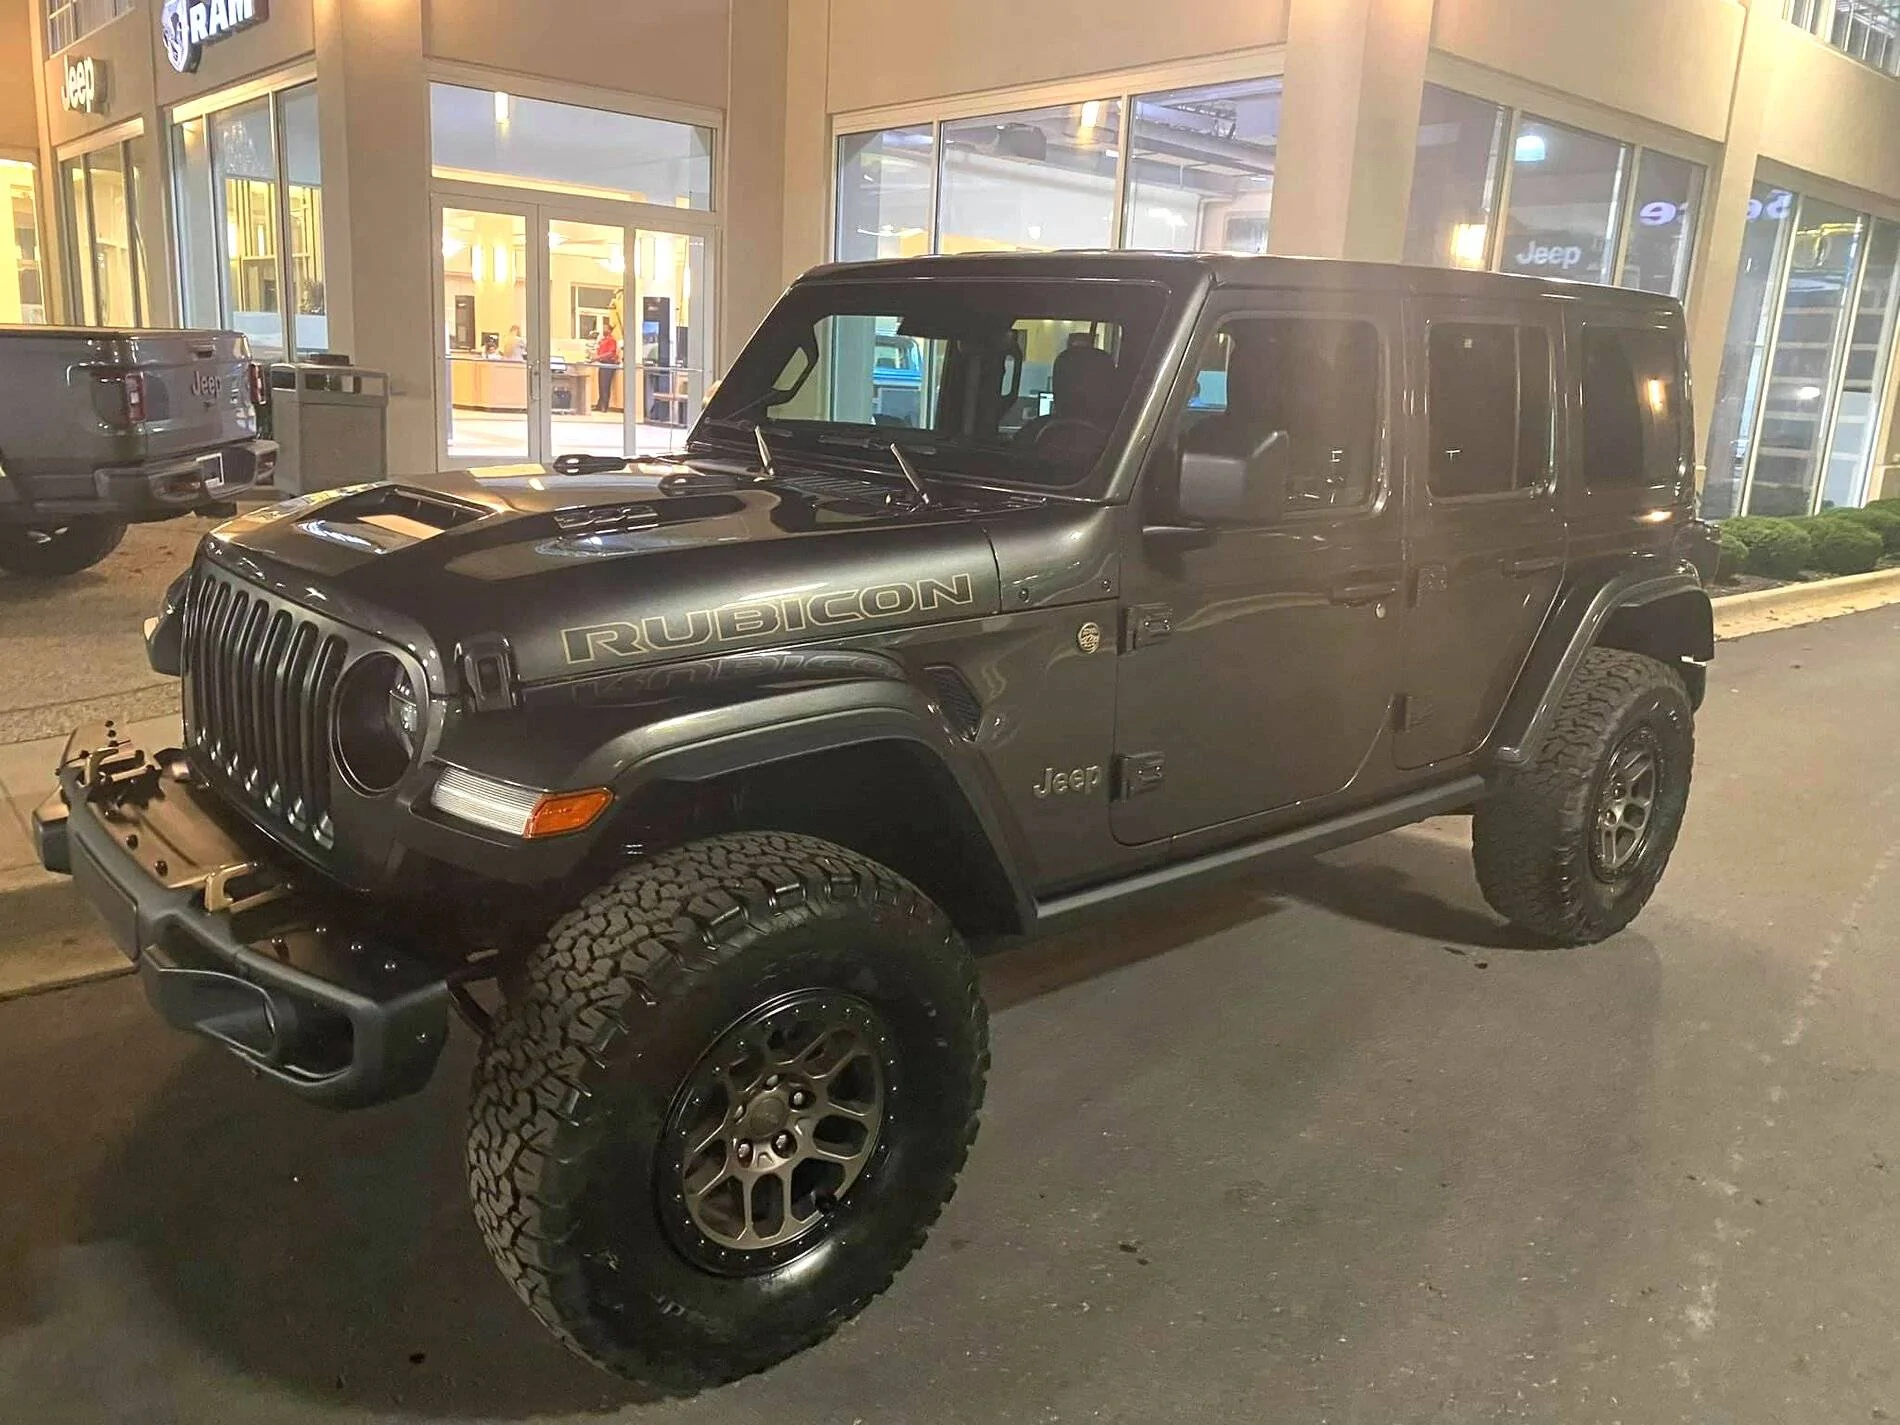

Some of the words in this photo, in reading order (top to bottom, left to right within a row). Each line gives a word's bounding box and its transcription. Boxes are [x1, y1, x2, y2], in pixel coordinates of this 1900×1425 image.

[60, 54, 95, 113] Jeep
[1516, 240, 1582, 270] Jeep
[191, 370, 222, 399] Jeep
[560, 573, 974, 665] RUBICON
[1033, 765, 1102, 799] Jeep
